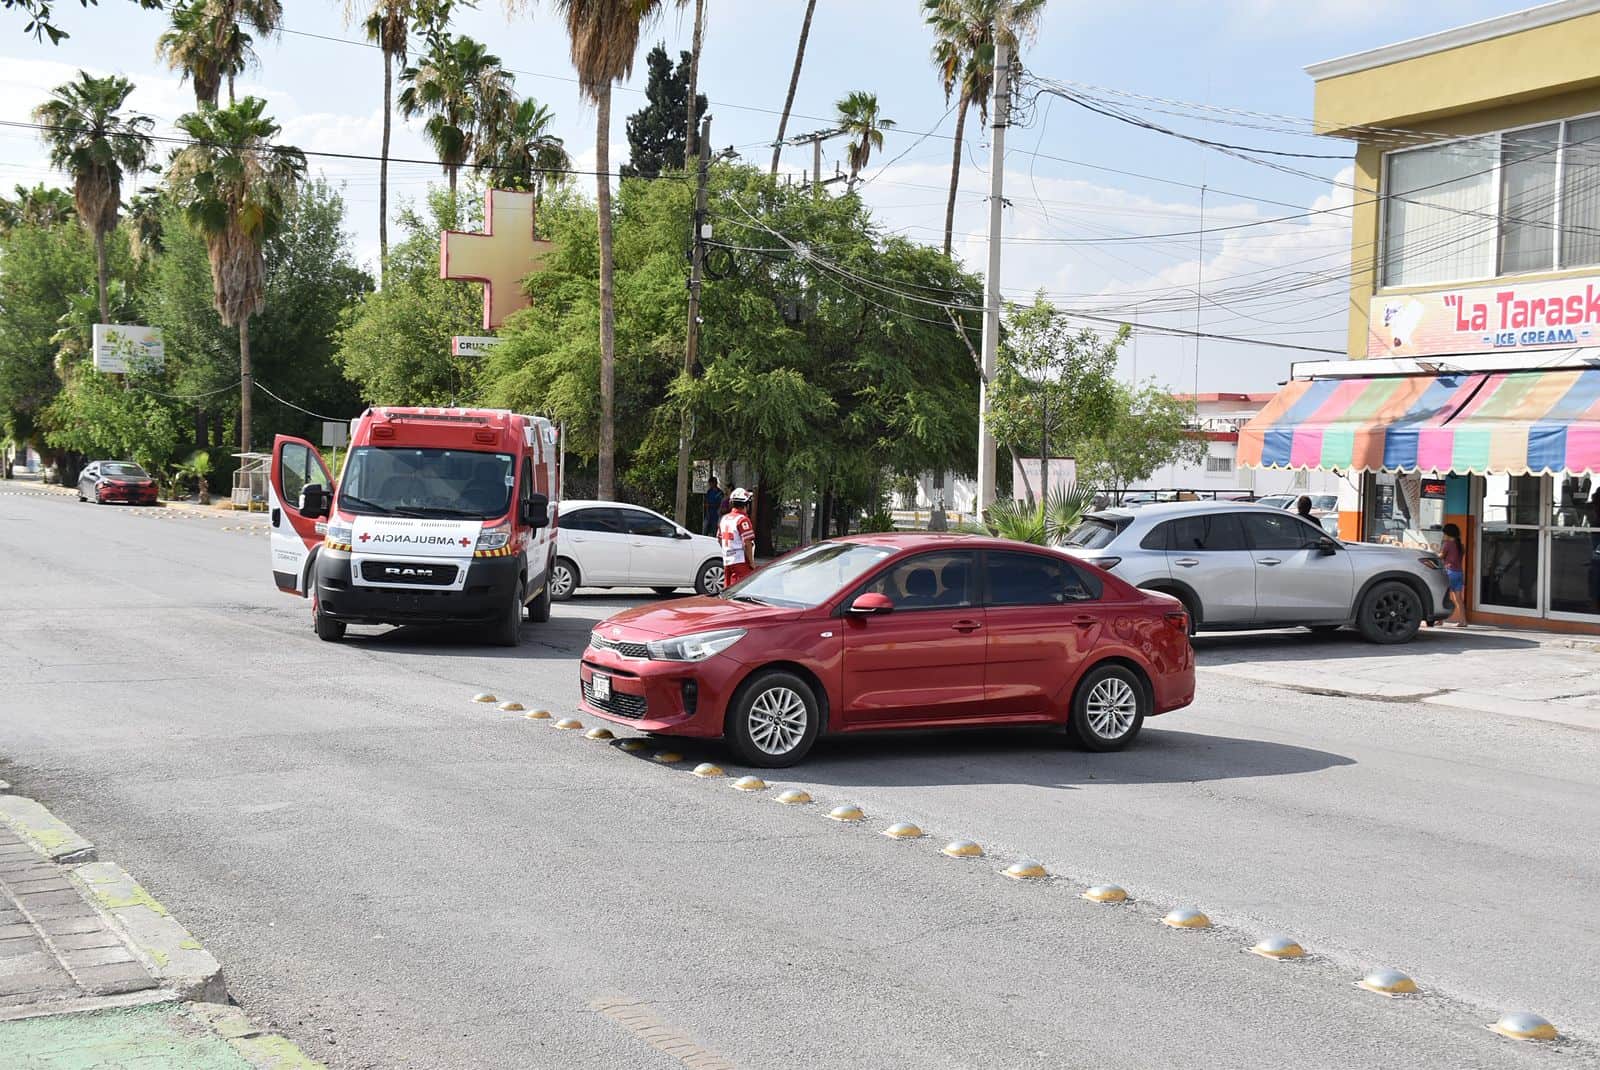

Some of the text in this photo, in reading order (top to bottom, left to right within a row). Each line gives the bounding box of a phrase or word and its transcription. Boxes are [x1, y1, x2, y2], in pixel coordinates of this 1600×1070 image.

[1495, 329, 1575, 346] ICE CREAM
[459, 342, 485, 350] CRUZ
[385, 567, 433, 577] RAM
